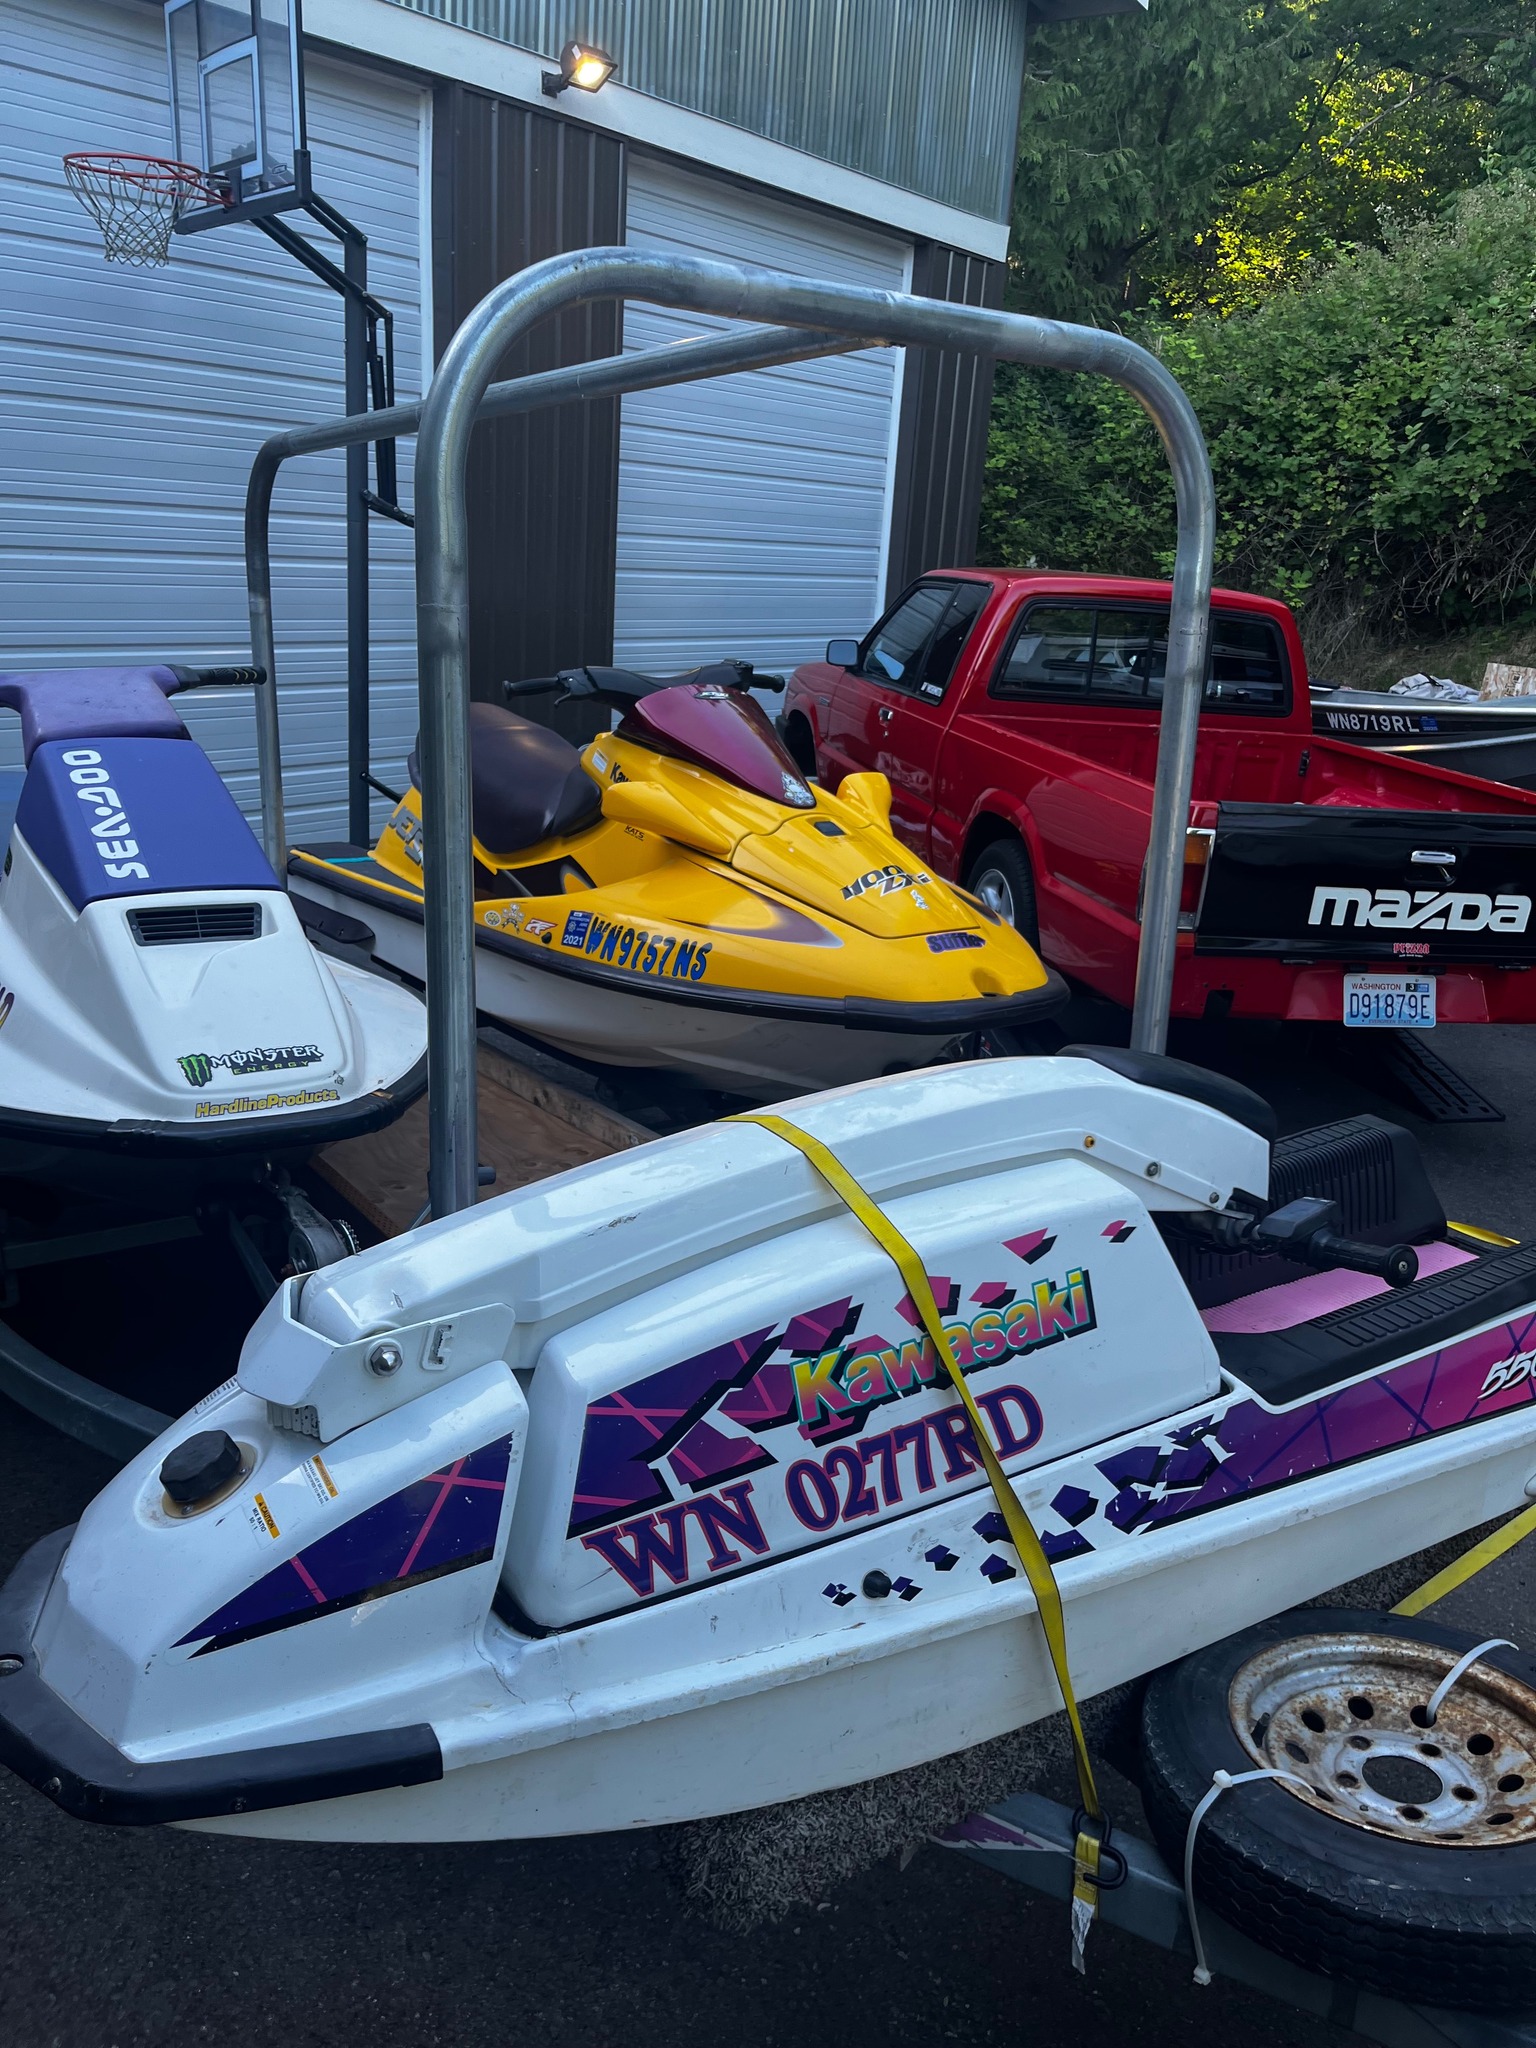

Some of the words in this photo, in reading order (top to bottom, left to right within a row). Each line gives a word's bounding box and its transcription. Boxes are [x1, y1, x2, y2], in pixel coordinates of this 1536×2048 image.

[1326, 712, 1419, 732] WN8719RL
[563, 934, 584, 947] 2021
[585, 916, 713, 981] WN9757NS
[1351, 983, 1401, 991] WASHINGTON
[1350, 993, 1430, 1020] D91879E
[211, 1045, 323, 1068] MONSTER
[233, 1061, 309, 1075] ENERGY
[790, 1266, 1093, 1424] Kawasaki
[581, 1479, 770, 1597] WN
[784, 1384, 1044, 1532] 0277RD
[260, 1505, 275, 1529] CAUTION
